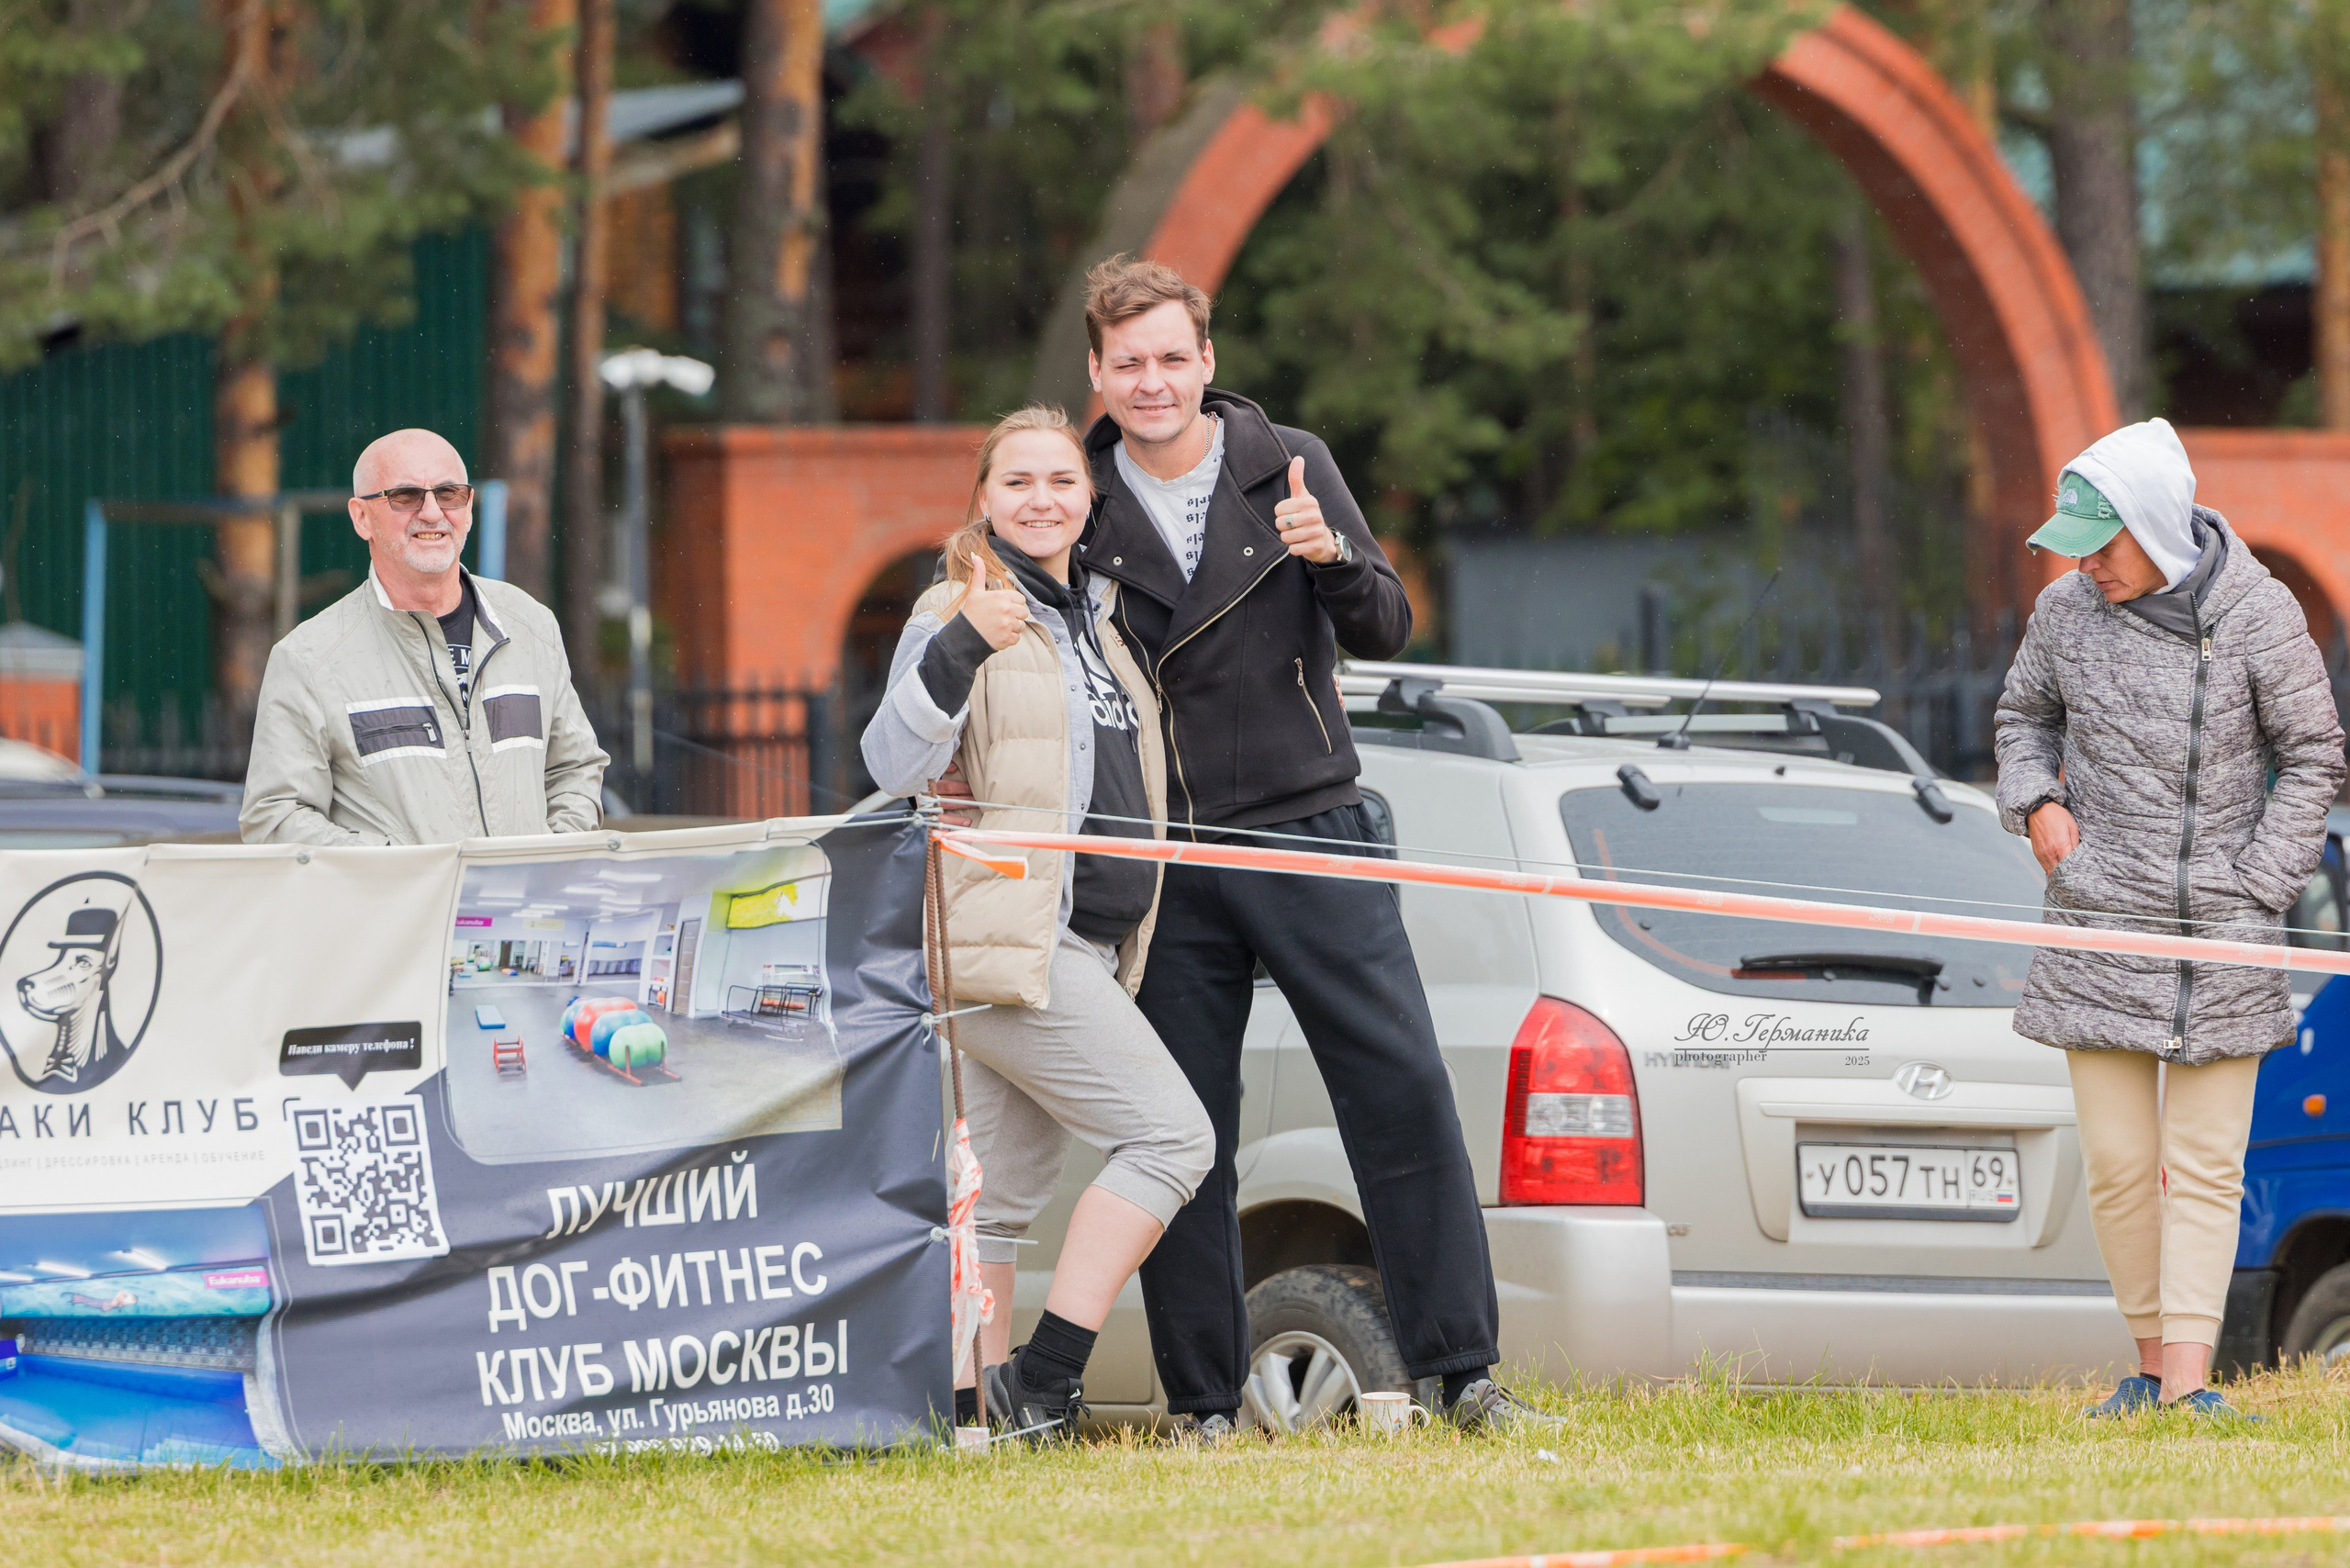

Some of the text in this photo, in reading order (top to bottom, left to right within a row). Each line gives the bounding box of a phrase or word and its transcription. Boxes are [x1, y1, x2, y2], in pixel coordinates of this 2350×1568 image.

[287, 1044, 323, 1056] Навели
[324, 1042, 361, 1055] камеру
[129, 1098, 259, 1136] КЛУБ
[45, 1156, 131, 1170] ДРЕССИРОВКА
[143, 1153, 190, 1165] АРЕНДА
[202, 1149, 265, 1163] ОБУЧЕНИЕ
[1973, 1155, 2004, 1188] 69
[545, 1149, 759, 1240] ЛУЧШИЙ
[207, 1274, 263, 1285] Eukanuba
[487, 1241, 828, 1334] ДОГ-ФИТНЕС
[476, 1319, 848, 1406] КЛУБ МОСКВЫ
[501, 1383, 835, 1441] Москва, ул. Гурьянова д.30
